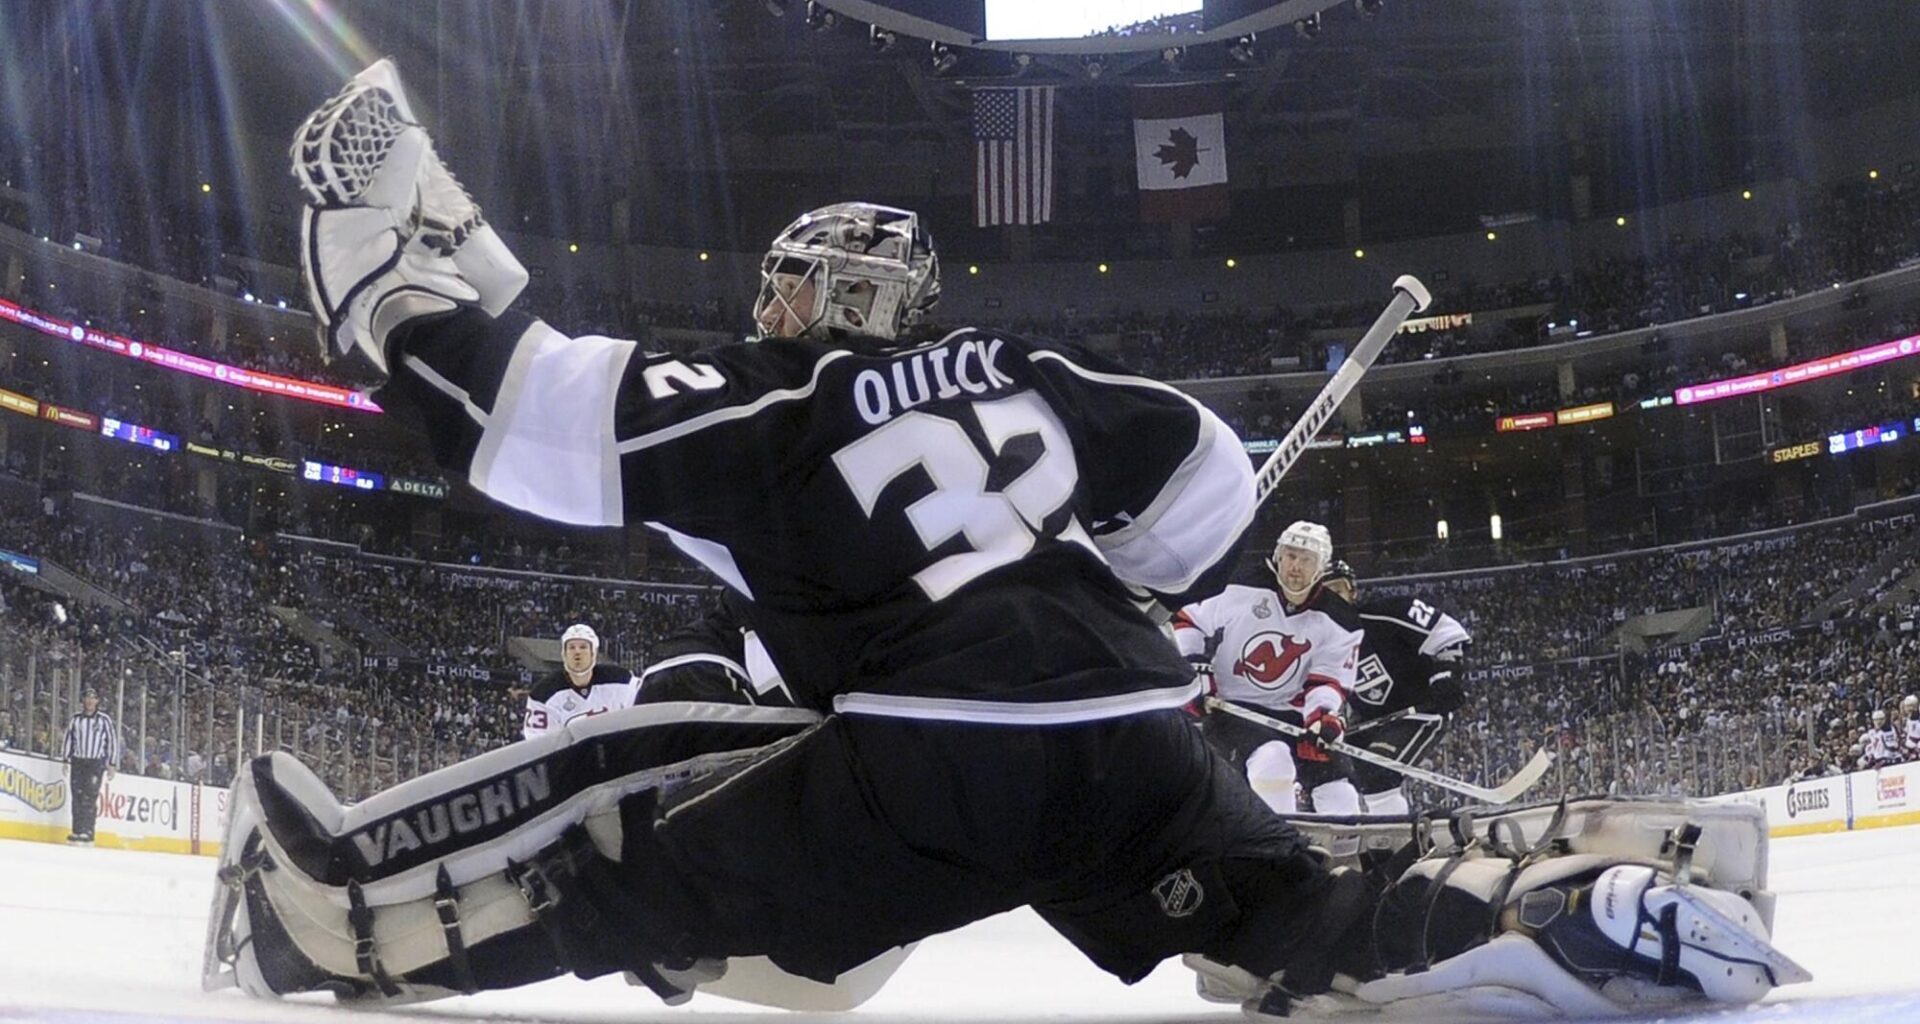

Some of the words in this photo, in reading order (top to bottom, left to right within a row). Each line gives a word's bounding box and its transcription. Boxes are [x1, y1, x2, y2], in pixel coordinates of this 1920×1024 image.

[854, 338, 1013, 424] QUICK
[1257, 395, 1335, 500] ARRIOR
[1773, 442, 1820, 463] STAPLES
[404, 480, 443, 497] DELTA
[831, 389, 1078, 601] 32
[1728, 637, 1746, 650] LA
[1750, 630, 1792, 645] KINGS
[427, 664, 445, 676] LA
[450, 667, 490, 681] KINGS
[1469, 671, 1488, 681] LA
[1492, 666, 1534, 680] KINGS
[97, 783, 125, 819] oke
[1797, 788, 1829, 812] SERIES
[352, 763, 550, 866] VAUGHN
